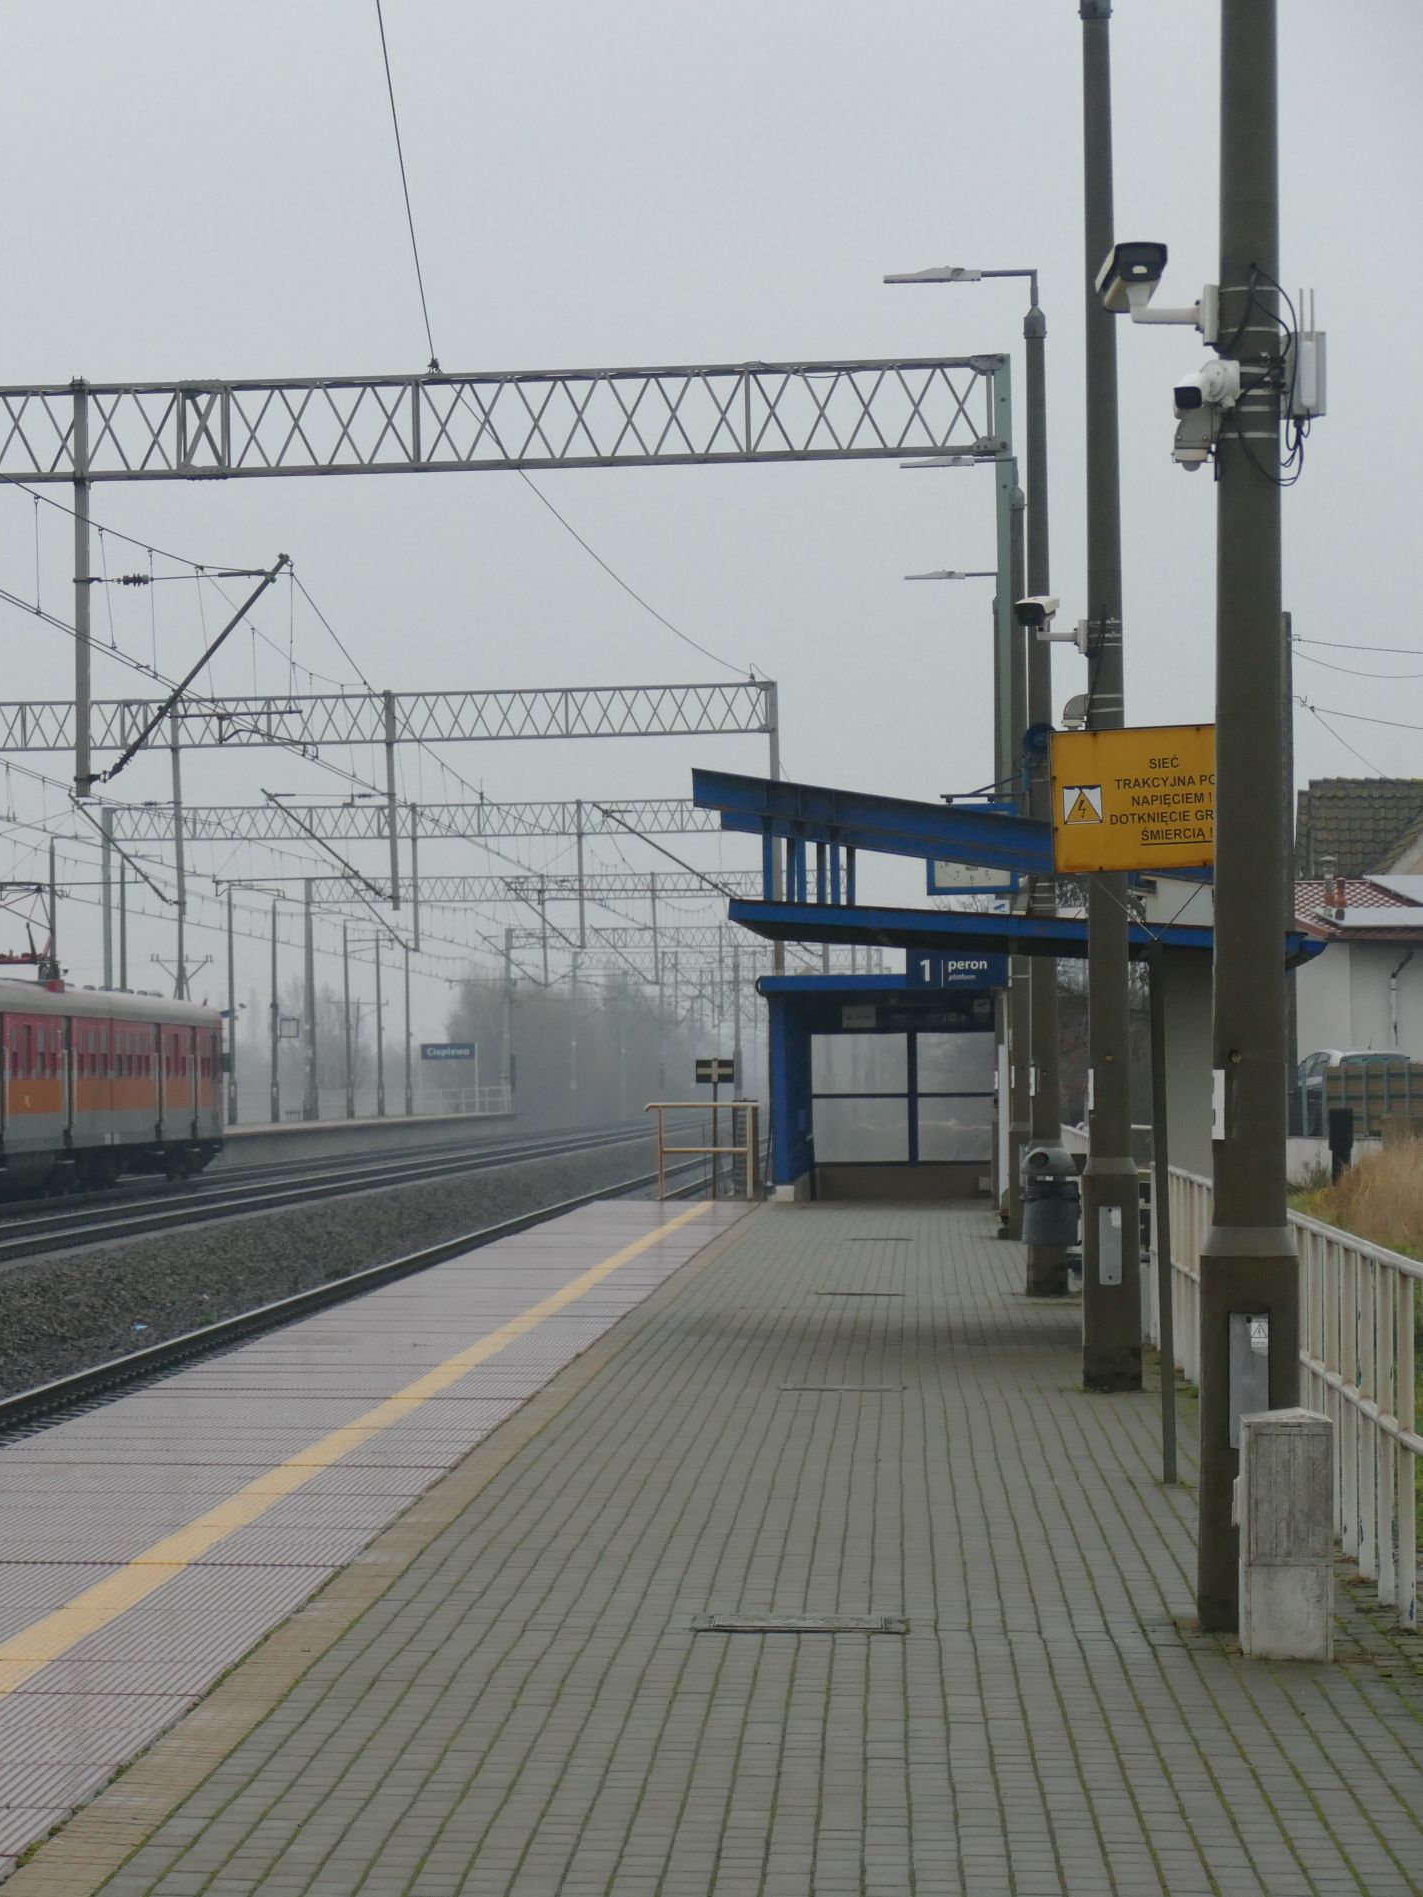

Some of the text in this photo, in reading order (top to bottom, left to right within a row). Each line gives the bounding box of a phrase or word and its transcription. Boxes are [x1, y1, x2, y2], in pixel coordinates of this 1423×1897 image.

[1149, 755, 1179, 769] SIEĆ
[1115, 774, 1215, 789] TRAKCYJNA PO
[1131, 792, 1205, 807] NAPIĘCIEM
[1110, 809, 1214, 825] DOTKNIĘCIE GR
[1141, 827, 1205, 842] ŚMIERCIĄ
[920, 959, 987, 982] 1 peron
